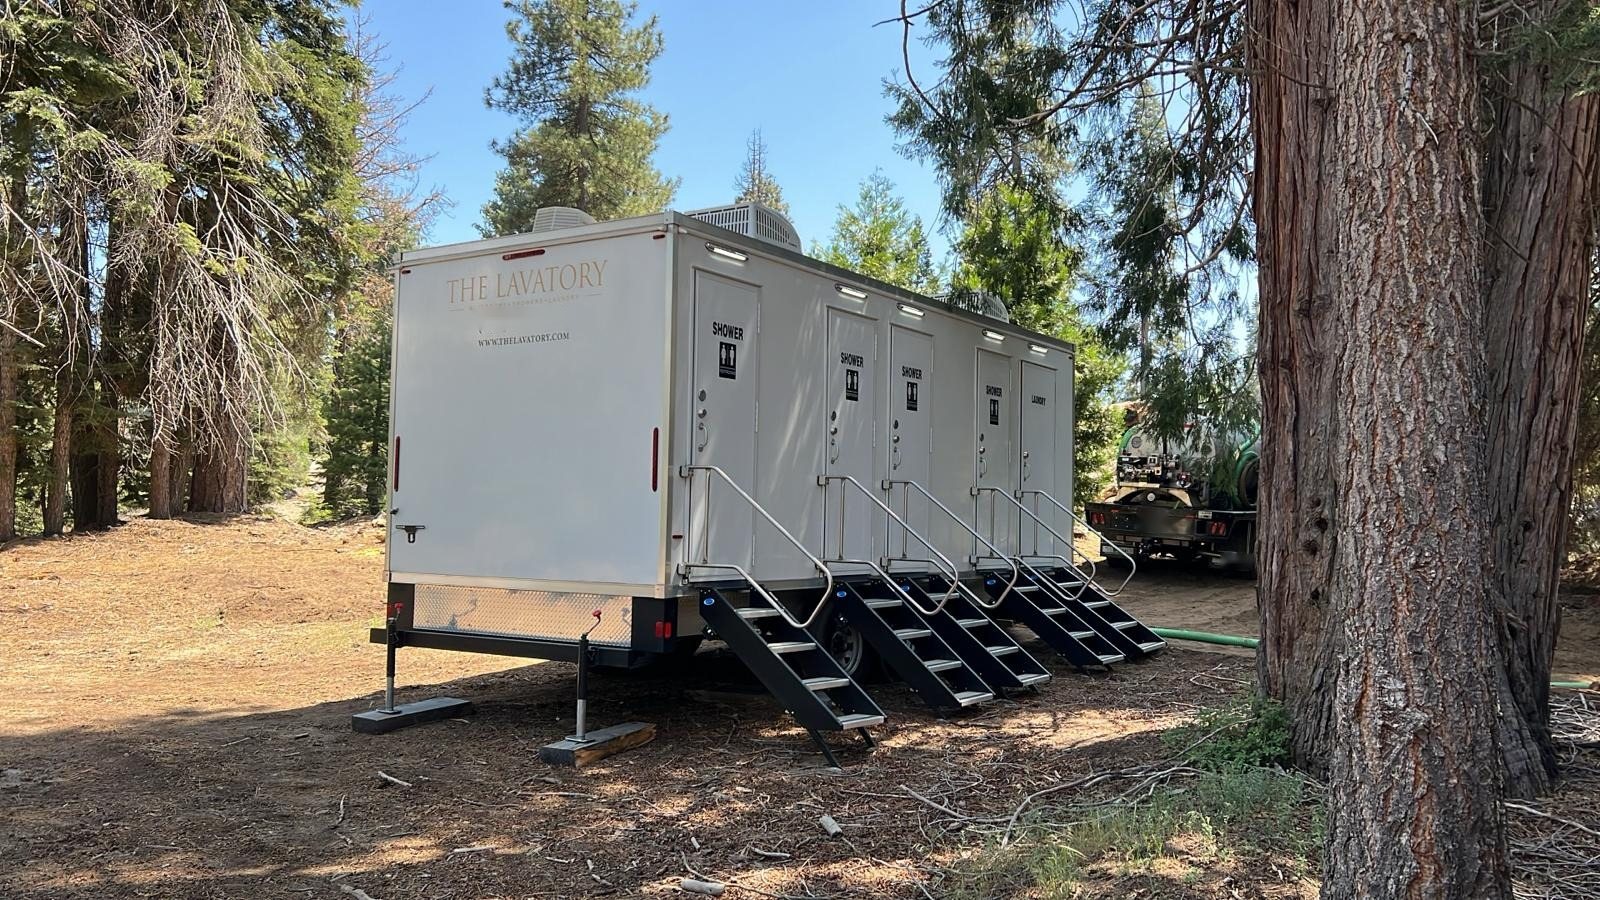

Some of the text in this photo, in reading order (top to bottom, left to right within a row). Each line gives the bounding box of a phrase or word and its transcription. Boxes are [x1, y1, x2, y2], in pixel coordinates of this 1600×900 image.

[447, 275, 488, 304] THE
[496, 259, 608, 297] LAVATORY
[712, 321, 744, 341] SHOWER
[478, 332, 570, 347] WWW.THELAVATORY.COM
[840, 352, 864, 368] SHOWER
[901, 365, 922, 380] SHOWER
[986, 384, 1002, 398] SHOWER
[1031, 395, 1046, 406] LAUNDRY
